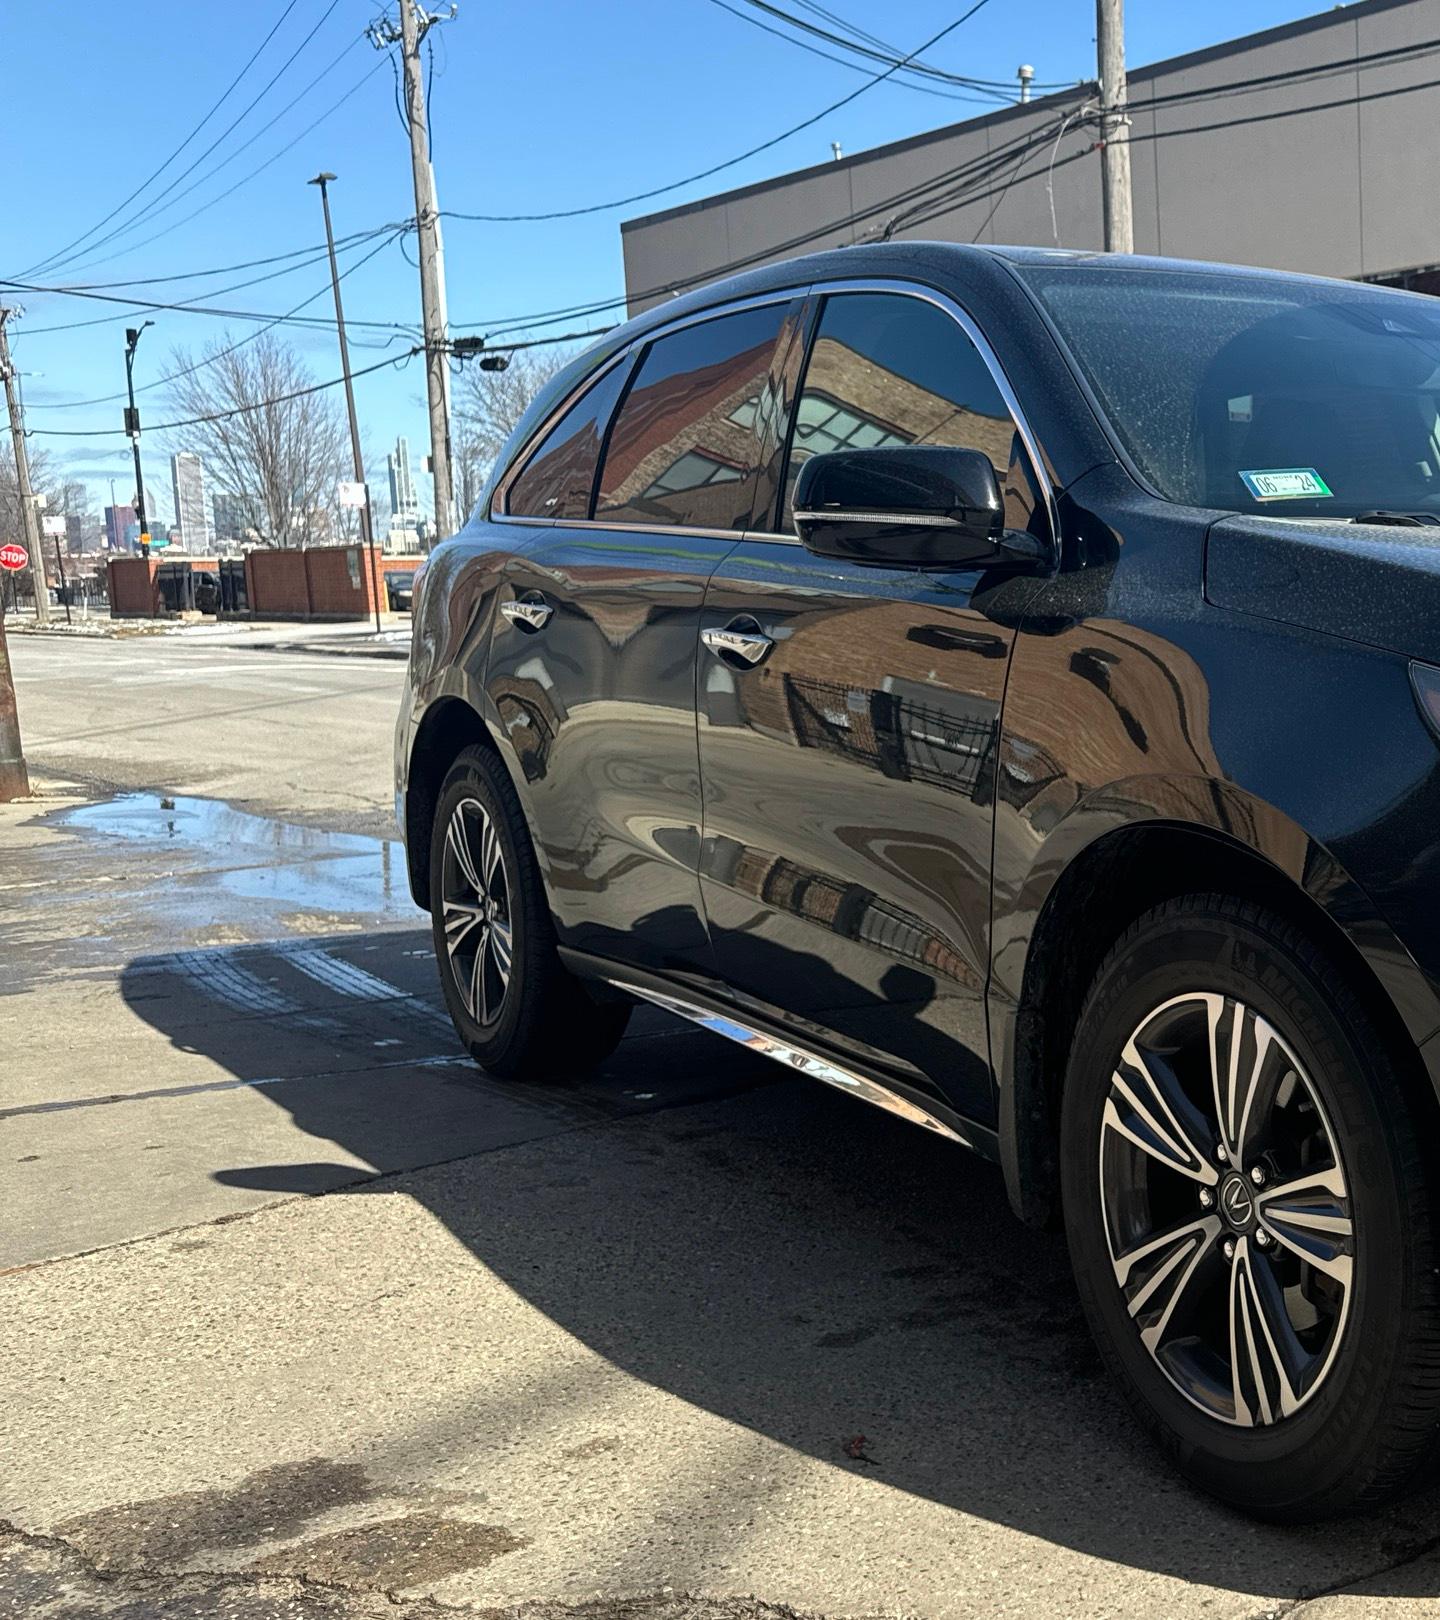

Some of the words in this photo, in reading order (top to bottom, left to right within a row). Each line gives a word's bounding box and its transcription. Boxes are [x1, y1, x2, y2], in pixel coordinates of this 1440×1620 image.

[1256, 477, 1278, 493] 06
[1294, 475, 1316, 491] 24
[0, 551, 25, 563] STOP
[1259, 962, 1367, 1125] MICHELIN
